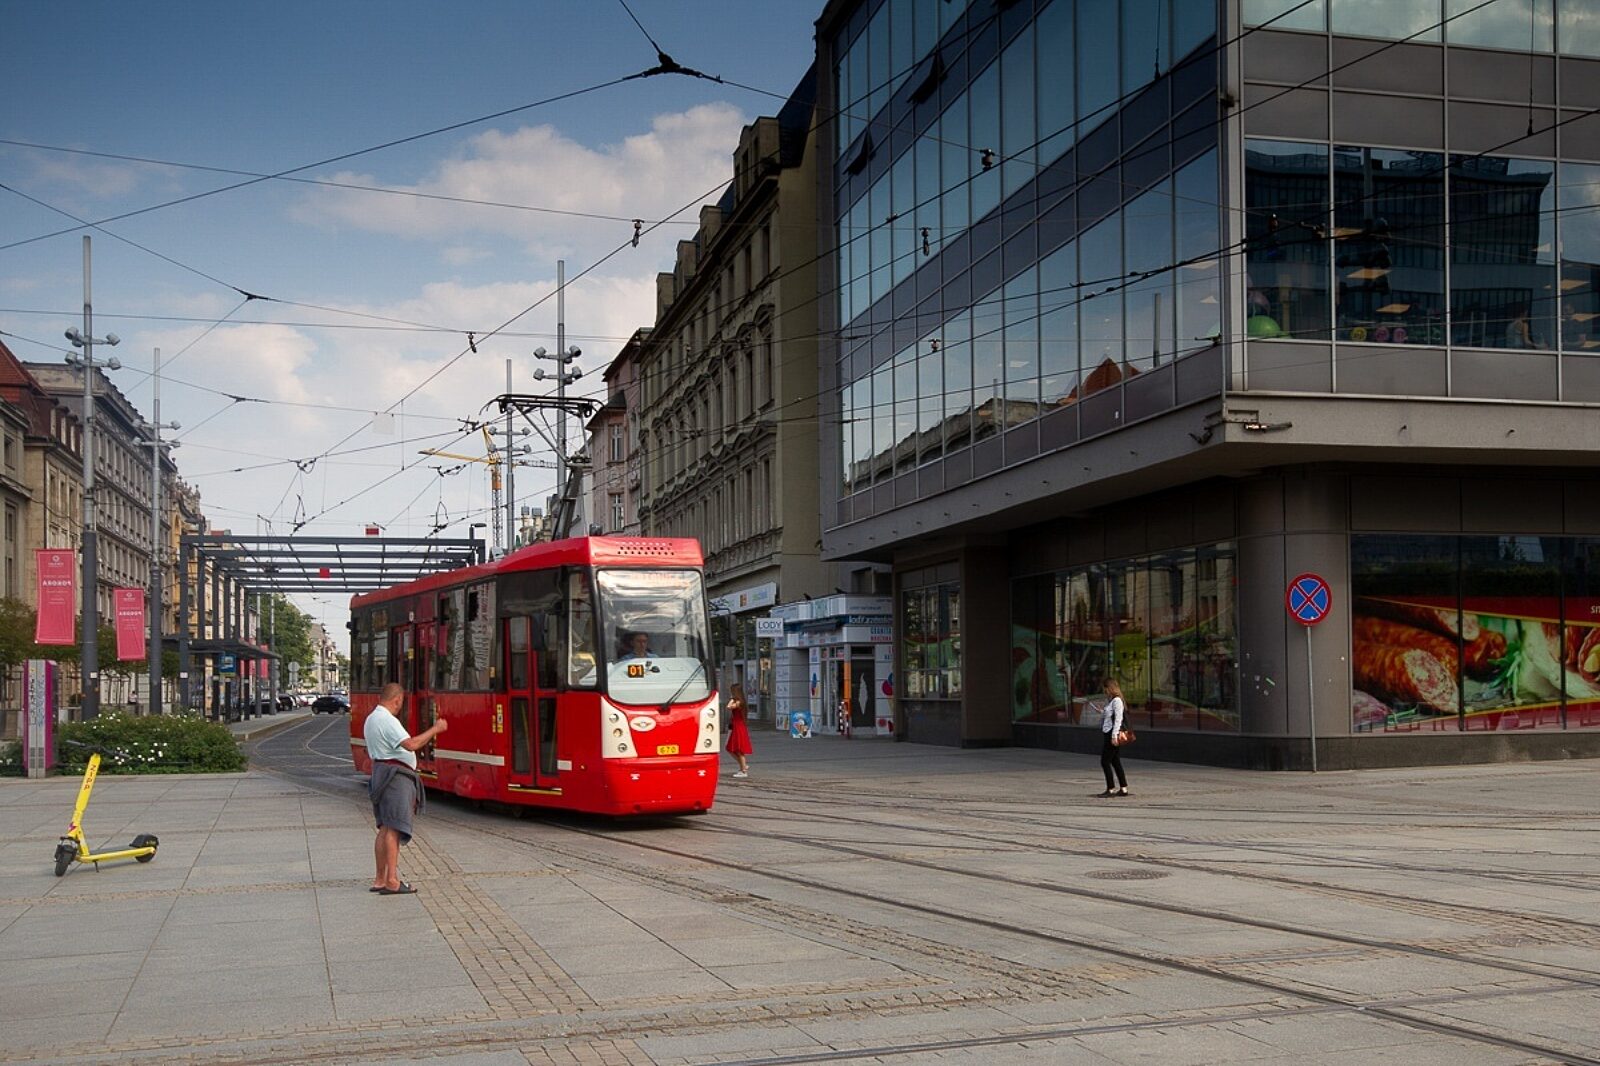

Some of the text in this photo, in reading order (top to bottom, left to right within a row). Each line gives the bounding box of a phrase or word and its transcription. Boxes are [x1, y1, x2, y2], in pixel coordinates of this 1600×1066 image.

[758, 621, 782, 629] LODY
[630, 666, 642, 676] 01
[659, 746, 676, 754] 670
[83, 764, 96, 791] ZIPP
